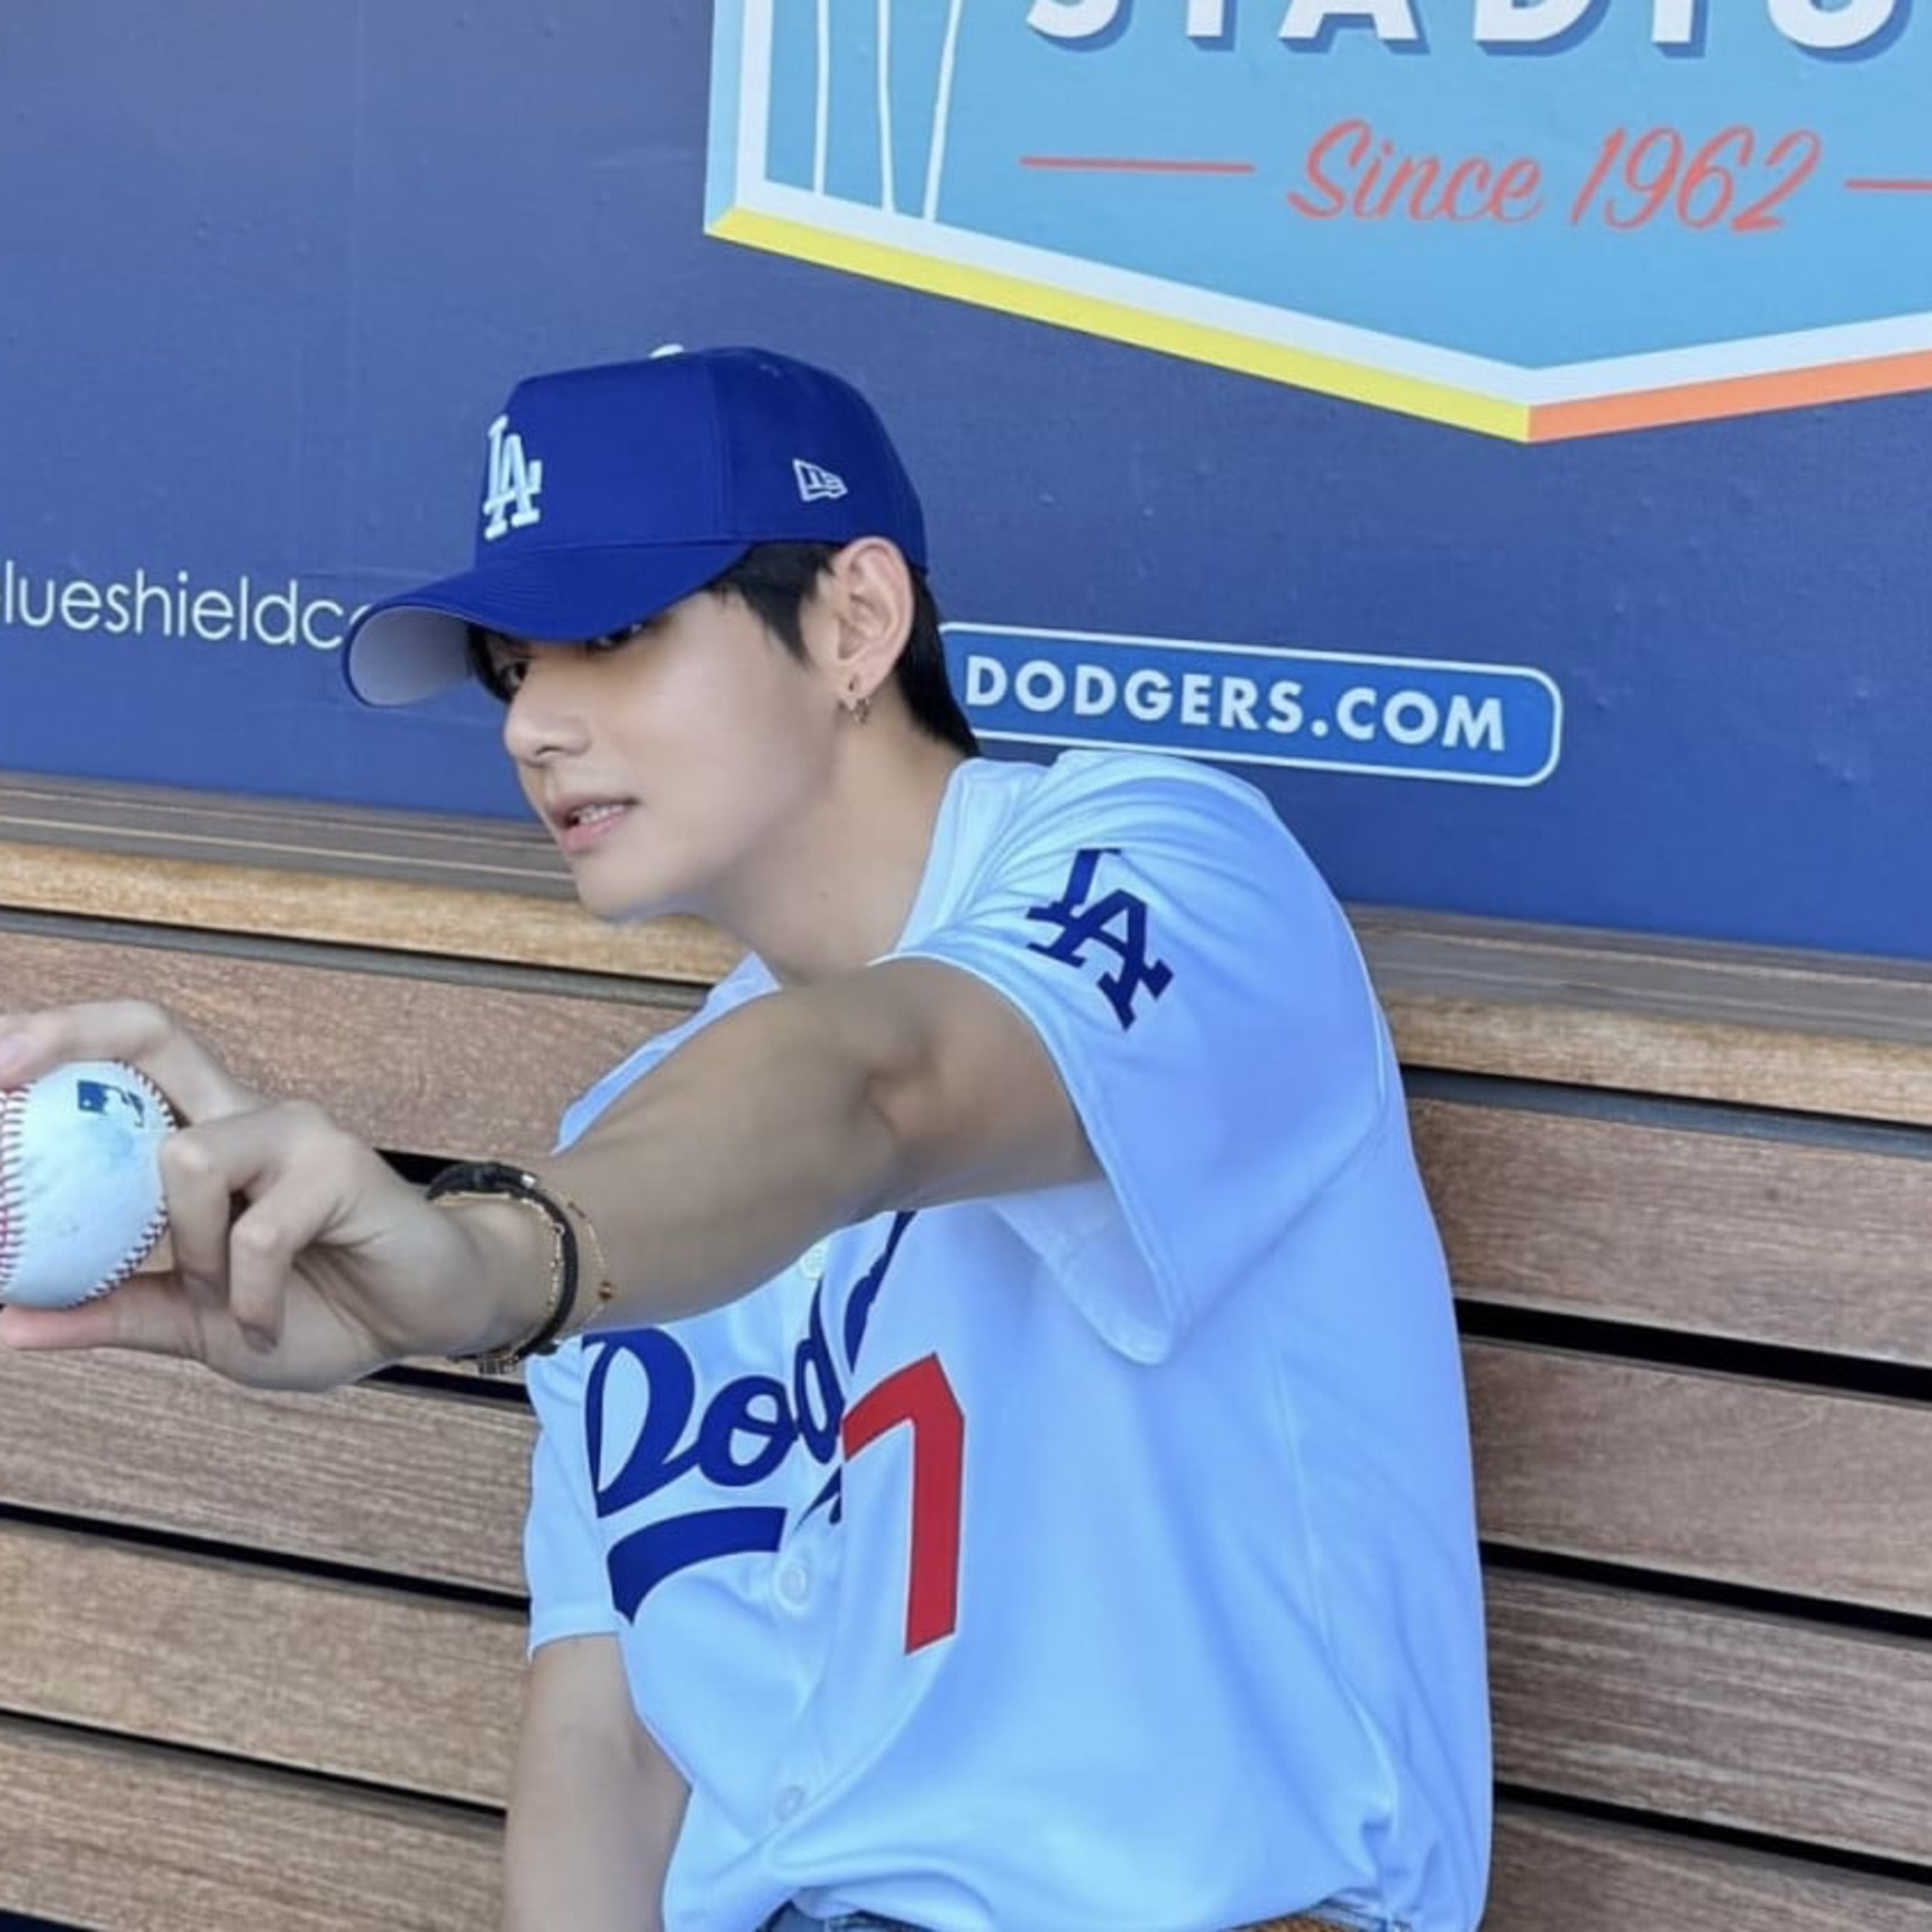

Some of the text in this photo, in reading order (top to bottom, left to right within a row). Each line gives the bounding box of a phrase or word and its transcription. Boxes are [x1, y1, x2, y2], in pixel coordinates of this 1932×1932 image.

[1286, 117, 1821, 232] Since 1962
[483, 415, 542, 541] LA
[5, 560, 374, 649] lueshieldc
[966, 655, 1505, 752] DODGERS.COM
[1026, 848, 1173, 1032] LA
[582, 1278, 847, 1530] Dod
[842, 1352, 965, 1655] 7
